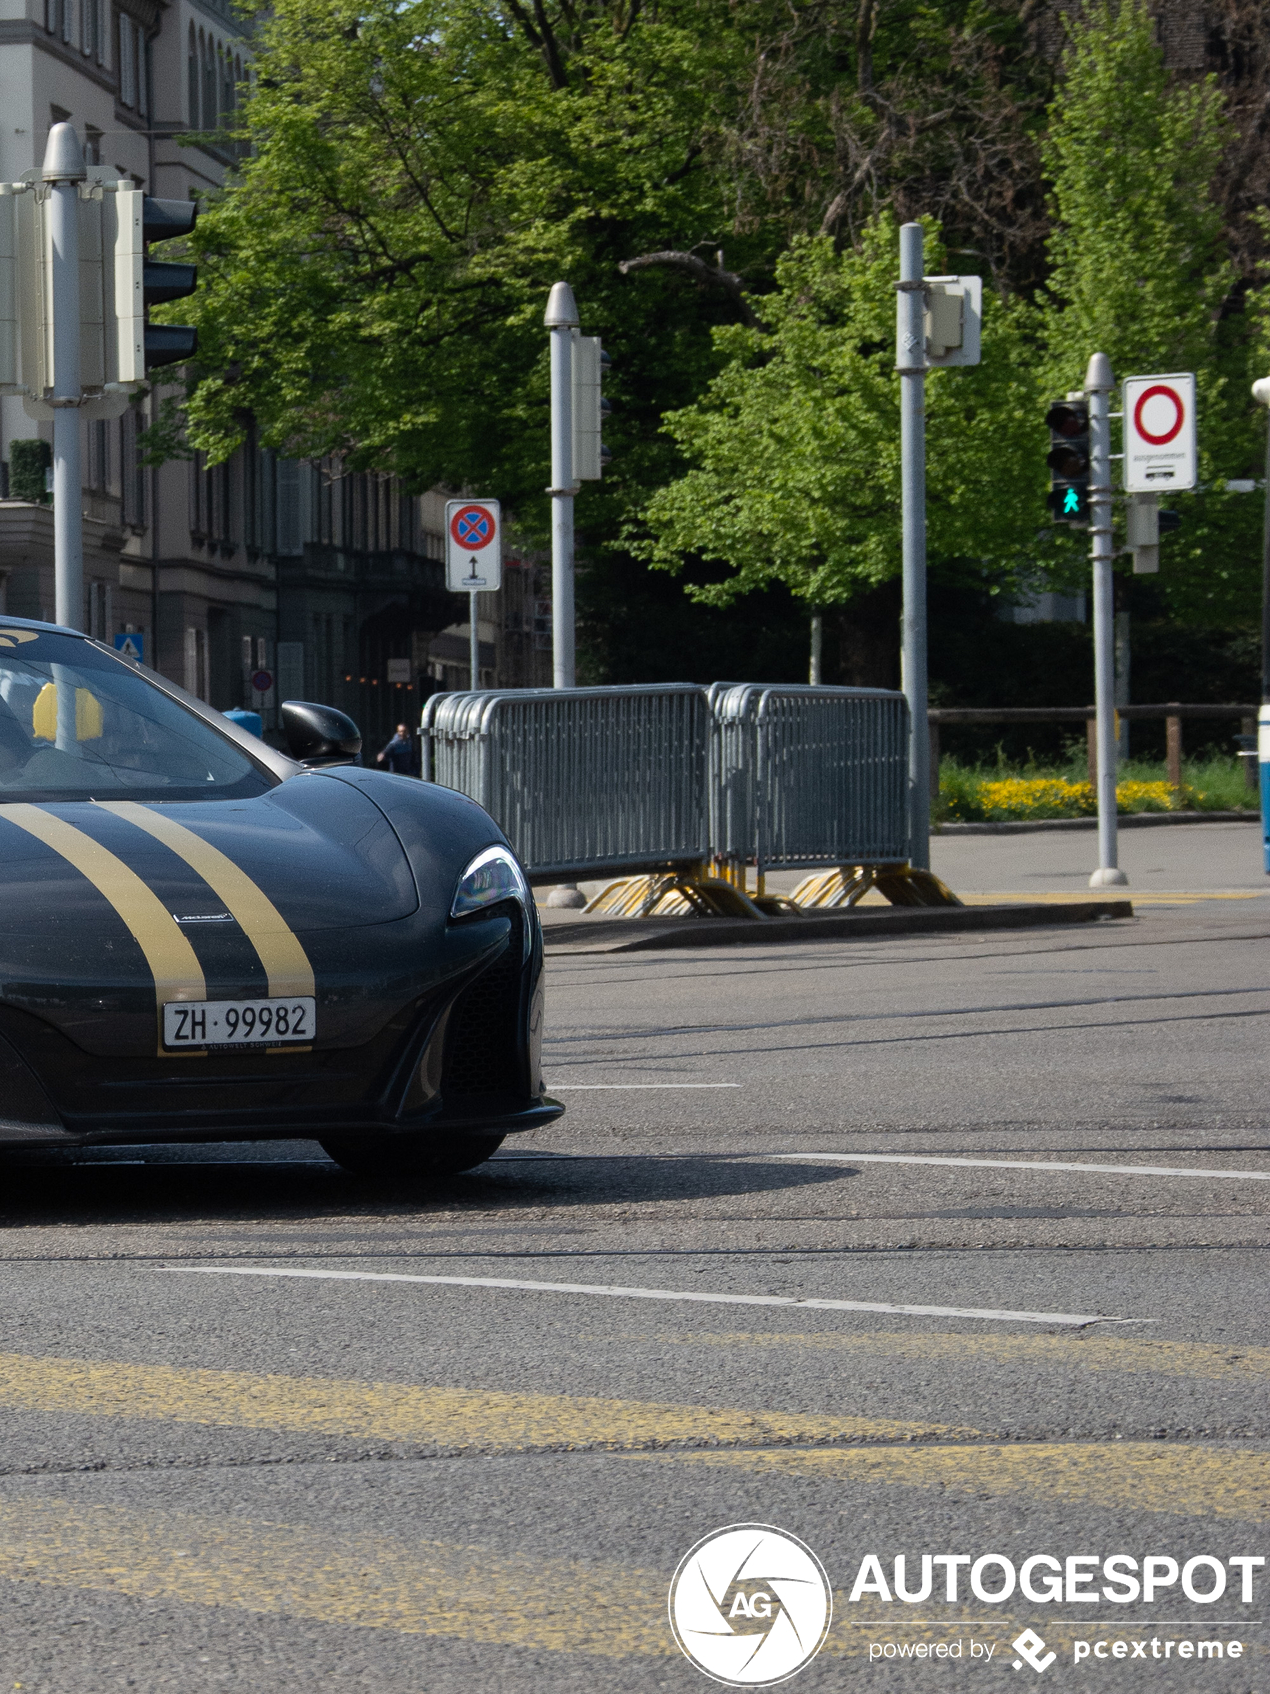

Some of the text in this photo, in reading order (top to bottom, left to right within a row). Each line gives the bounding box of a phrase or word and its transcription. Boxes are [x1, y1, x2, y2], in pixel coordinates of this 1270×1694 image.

[174, 1006, 306, 1040] ZH 99982
[209, 1042, 247, 1050] AUTOWELT
